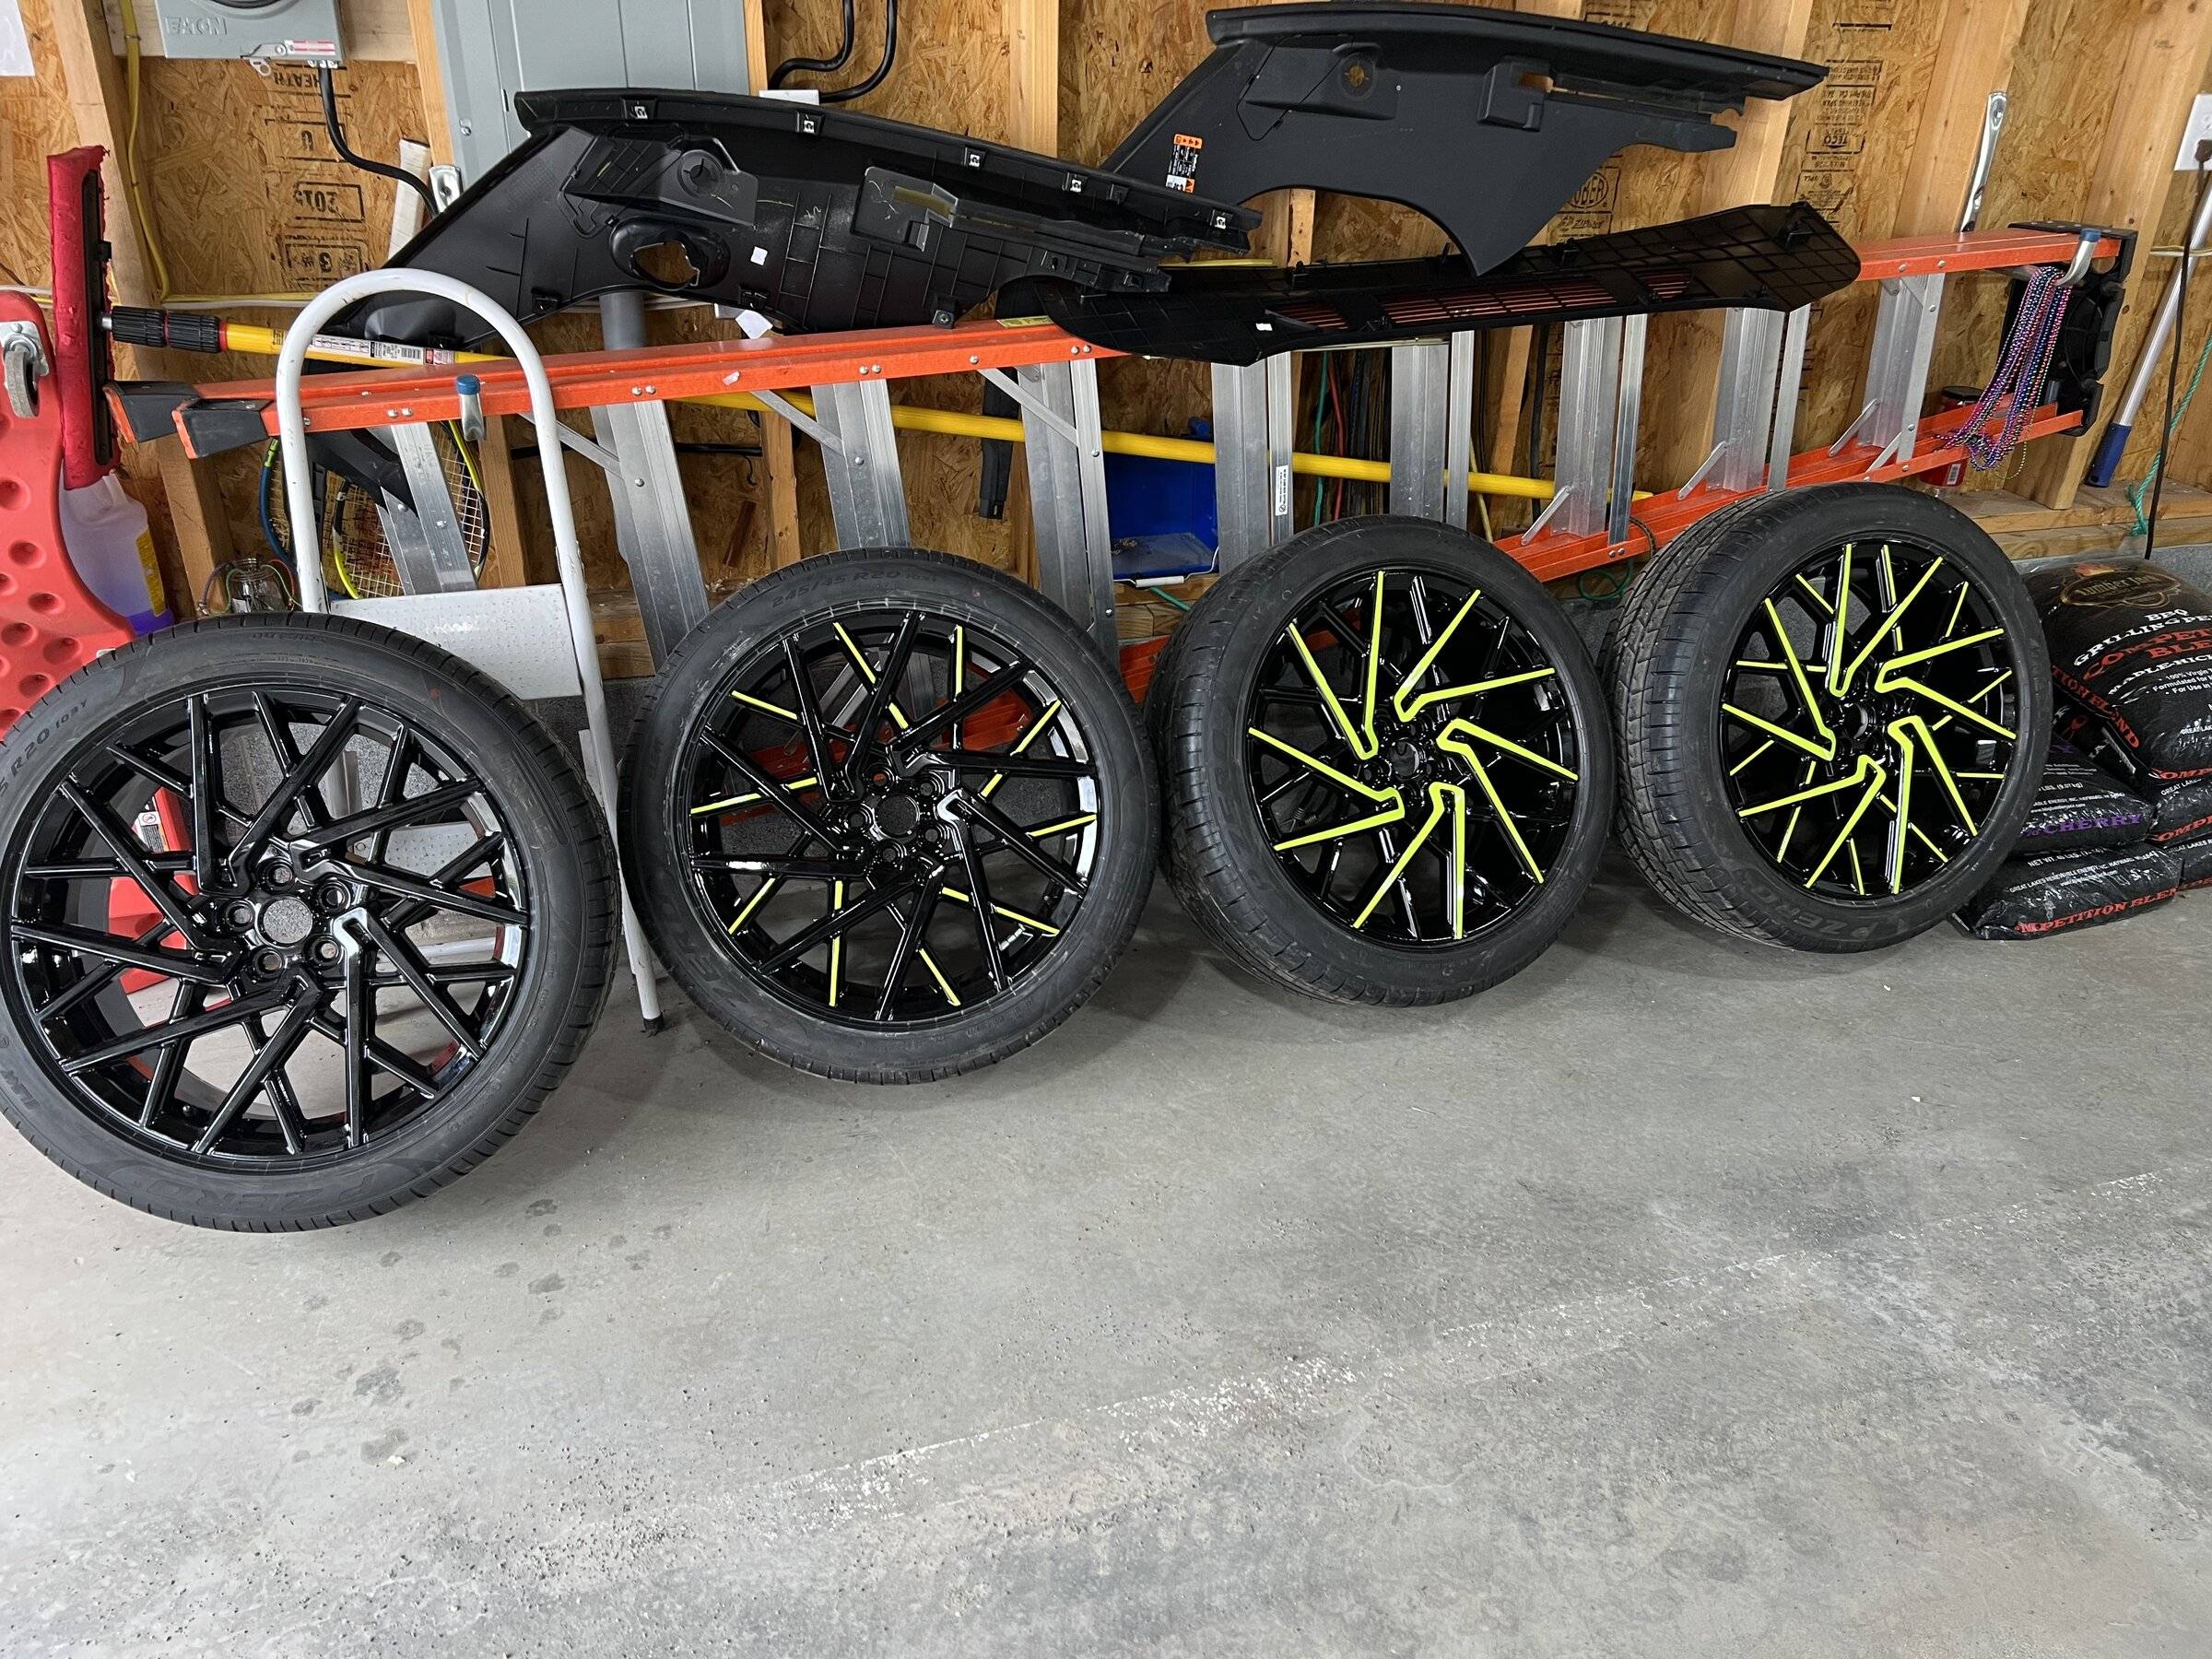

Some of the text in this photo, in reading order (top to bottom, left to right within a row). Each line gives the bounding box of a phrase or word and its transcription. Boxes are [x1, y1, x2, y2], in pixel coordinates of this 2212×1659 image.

[164, 16, 228, 37] EATON
[1571, 174, 1605, 206] UBER
[771, 572, 848, 609] 245/45
[853, 571, 900, 581] R20
[2144, 608, 2189, 622] BBQ
[2074, 618, 2181, 666] GRILLING
[2166, 668, 2208, 681] 100% Virgin
[2152, 677, 2197, 691] Formulated
[2171, 686, 2186, 694] For
[10, 727, 51, 778] R20
[2042, 812, 2144, 834] CHERRY
[2027, 859, 2043, 867] NET
[2027, 877, 2046, 888] LAKES
